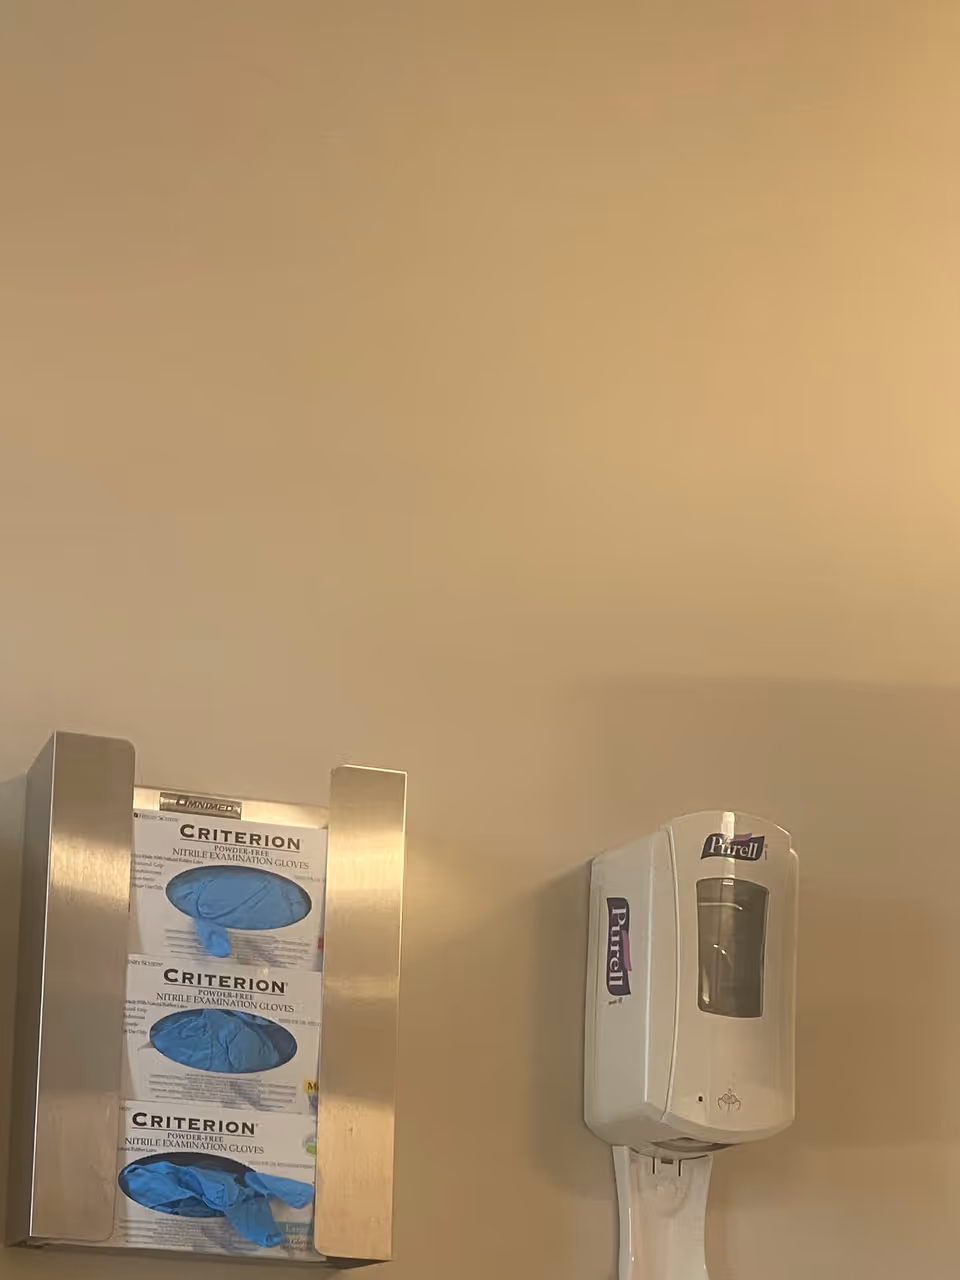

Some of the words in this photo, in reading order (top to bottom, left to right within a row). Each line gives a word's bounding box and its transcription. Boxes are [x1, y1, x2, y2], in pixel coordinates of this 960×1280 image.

[176, 799, 234, 813] OMNIMED
[180, 824, 300, 850] CRITERION
[709, 836, 759, 858] Purell
[172, 847, 208, 859] NITRILE
[209, 850, 273, 866] EXAMINATION
[274, 857, 309, 869] GLOVES
[214, 845, 270, 858] POWDER-FREE
[609, 907, 627, 986] Purell
[163, 968, 285, 993] CRITERION
[156, 992, 192, 1003] NITRILE
[193, 996, 258, 1010] EXAMINATION
[259, 1002, 294, 1013] GLOVES
[198, 989, 254, 1001] POWDER-FREE
[132, 1112, 255, 1136] CRITERION
[124, 1137, 161, 1148] NITRILE
[162, 1140, 228, 1153] EXAMINATION
[229, 1146, 265, 1155] GLOVES
[167, 1132, 224, 1143] POWDER-FREE
